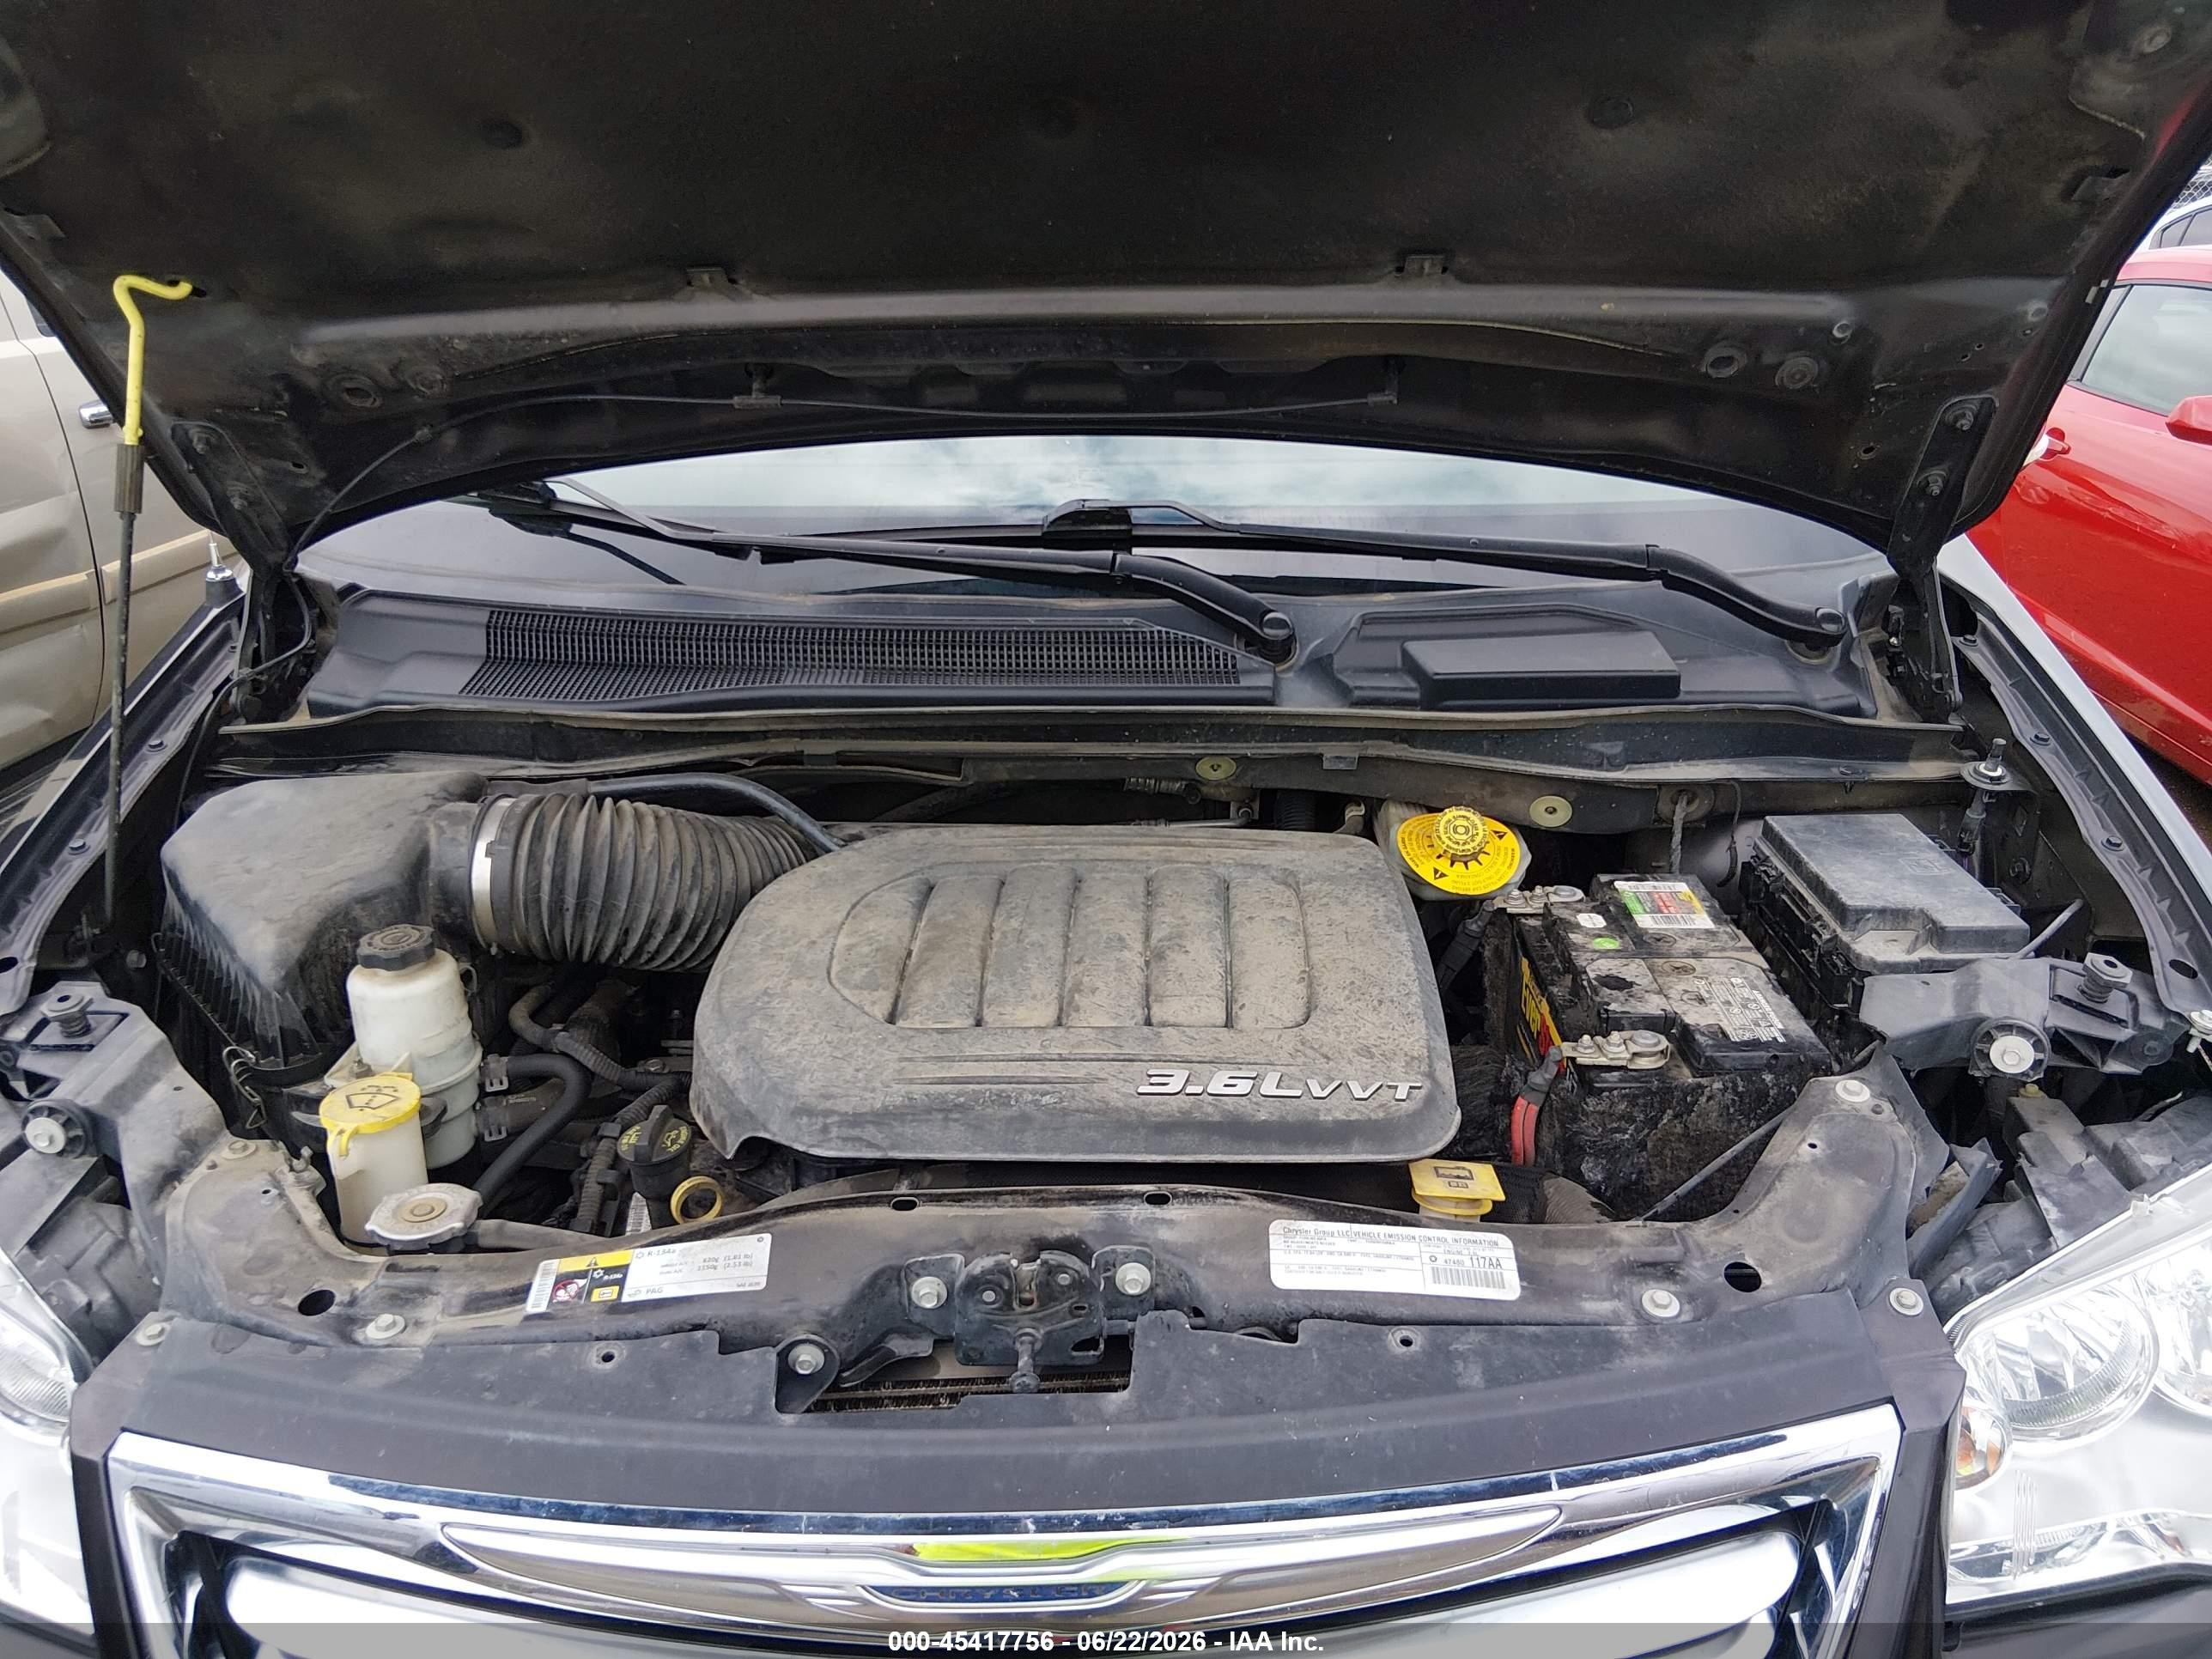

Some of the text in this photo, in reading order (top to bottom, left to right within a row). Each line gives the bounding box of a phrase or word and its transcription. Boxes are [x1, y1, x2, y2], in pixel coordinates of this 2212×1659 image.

[1305, 1079, 1424, 1102] VVT
[1283, 1226, 1311, 1235] Chrysler
[1314, 1228, 1334, 1237] Group
[1337, 1229, 1351, 1237] LLC
[1352, 1231, 1381, 1239] VEHICLE
[1383, 1232, 1416, 1242] EMISSION
[1419, 1235, 1449, 1244] CONTROL
[1451, 1237, 1499, 1247] INFORMATION
[1470, 1255, 1503, 1269] 117AA
[645, 1287, 664, 1296] PAG
[892, 1587, 1106, 1601] CHRYSLER
